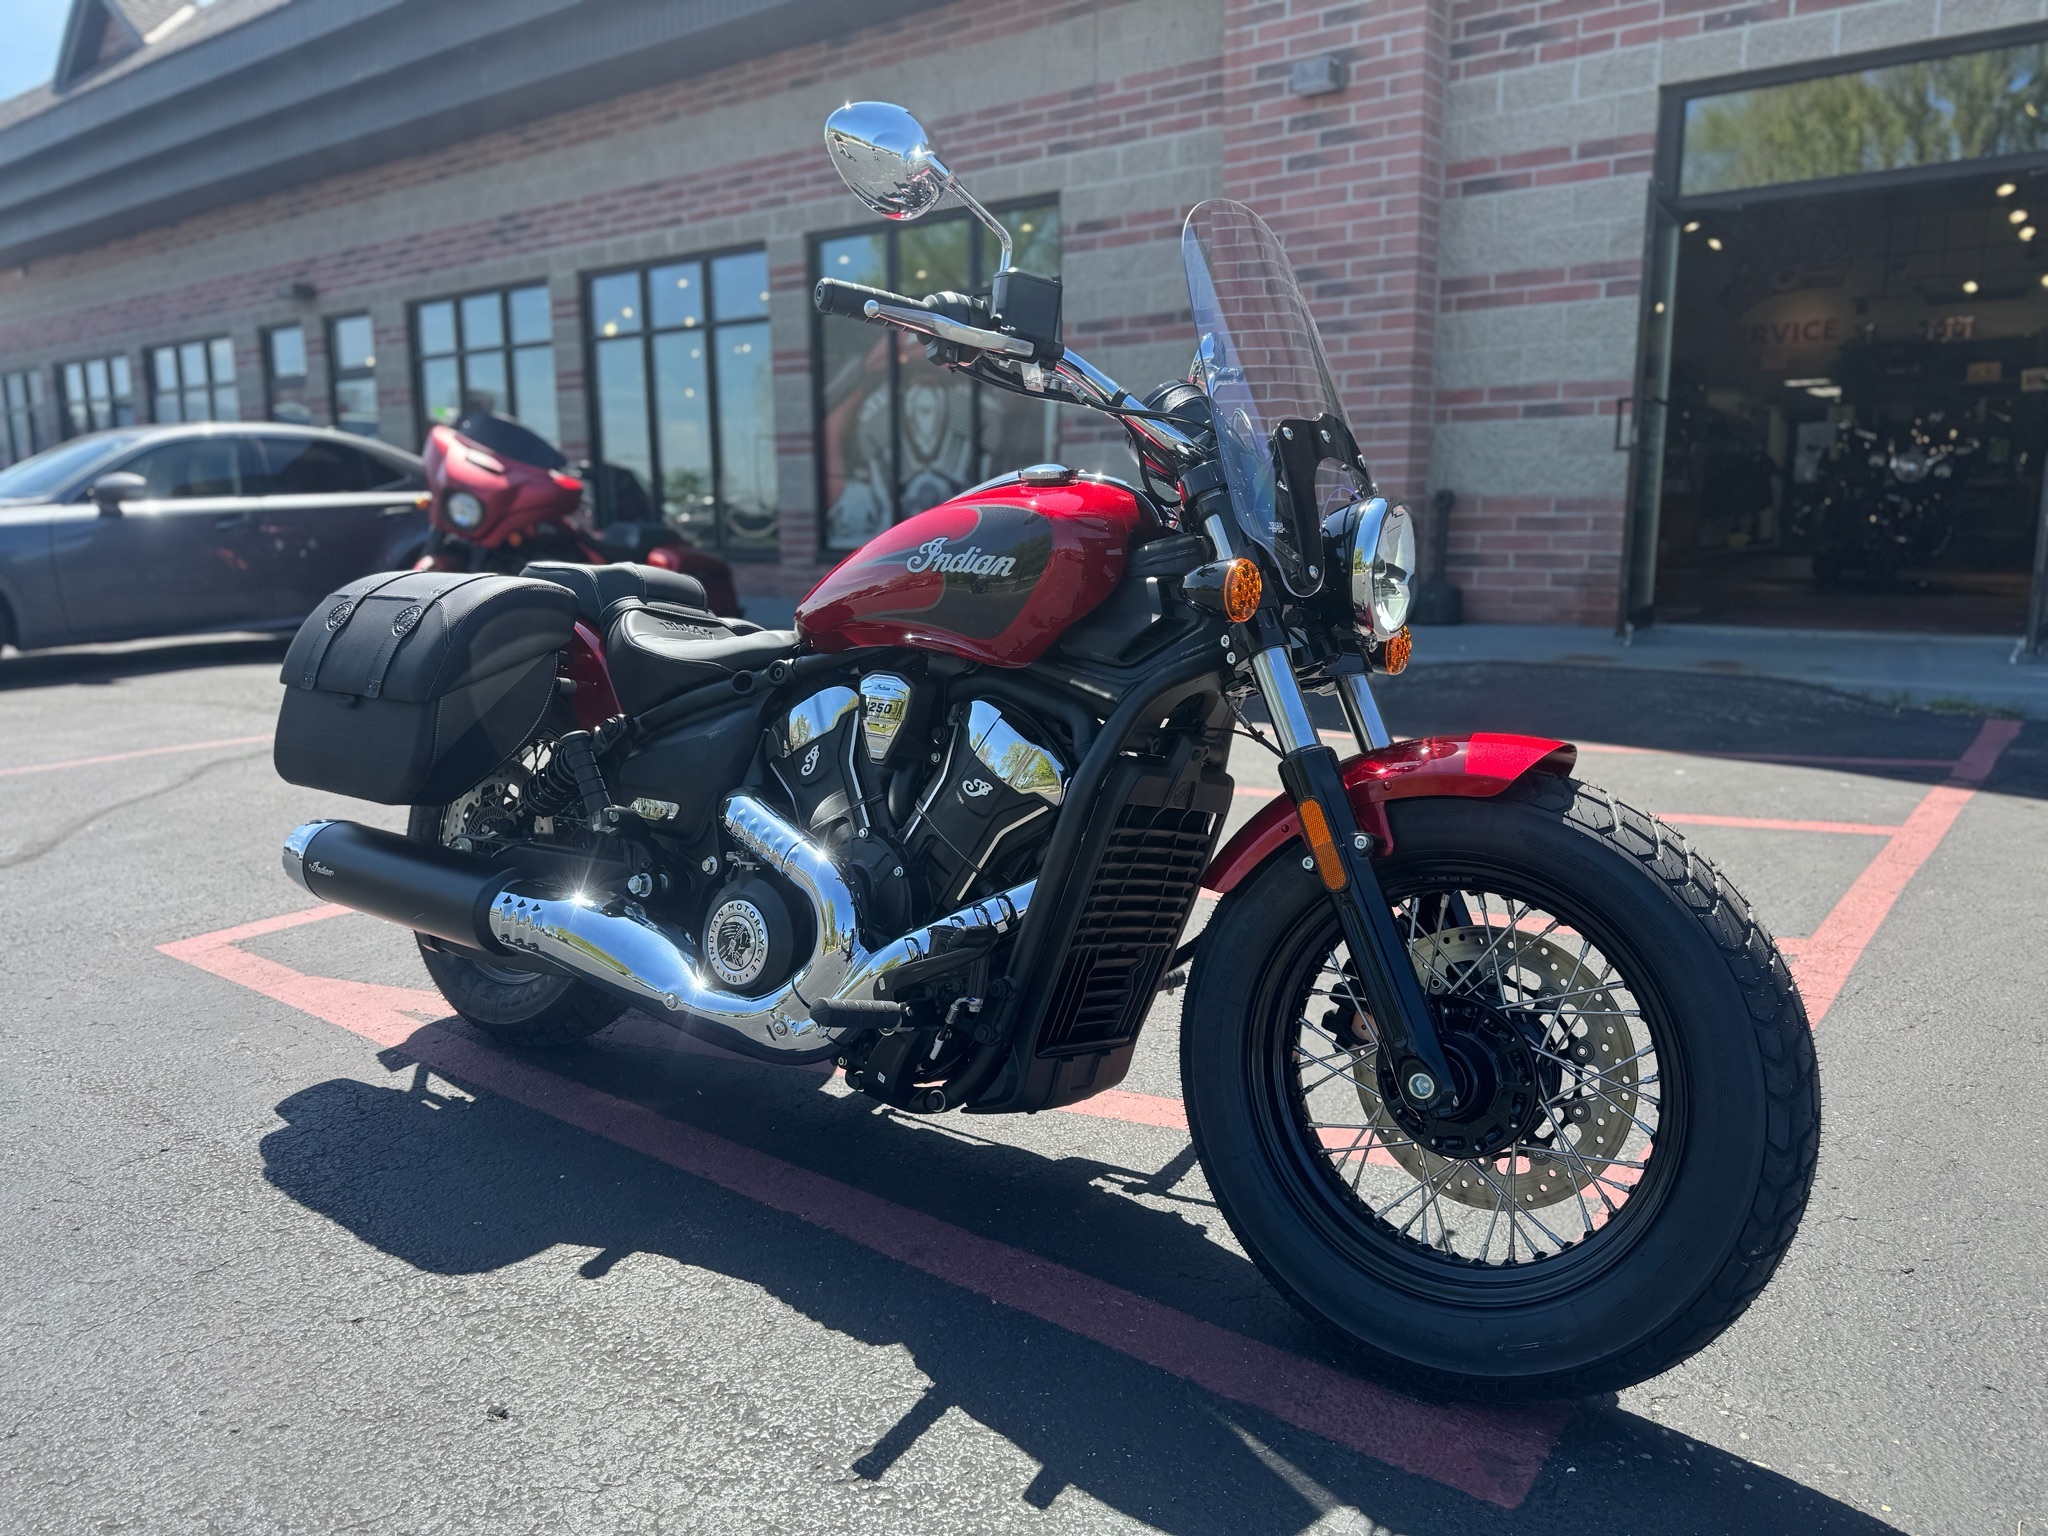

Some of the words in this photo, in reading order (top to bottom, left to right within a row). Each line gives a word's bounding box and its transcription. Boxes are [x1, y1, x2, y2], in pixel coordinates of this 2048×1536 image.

[906, 536, 1017, 577] Indian
[308, 861, 335, 877] Indian
[709, 910, 724, 961] INDIAN
[727, 903, 765, 973] MOTORCYCLE
